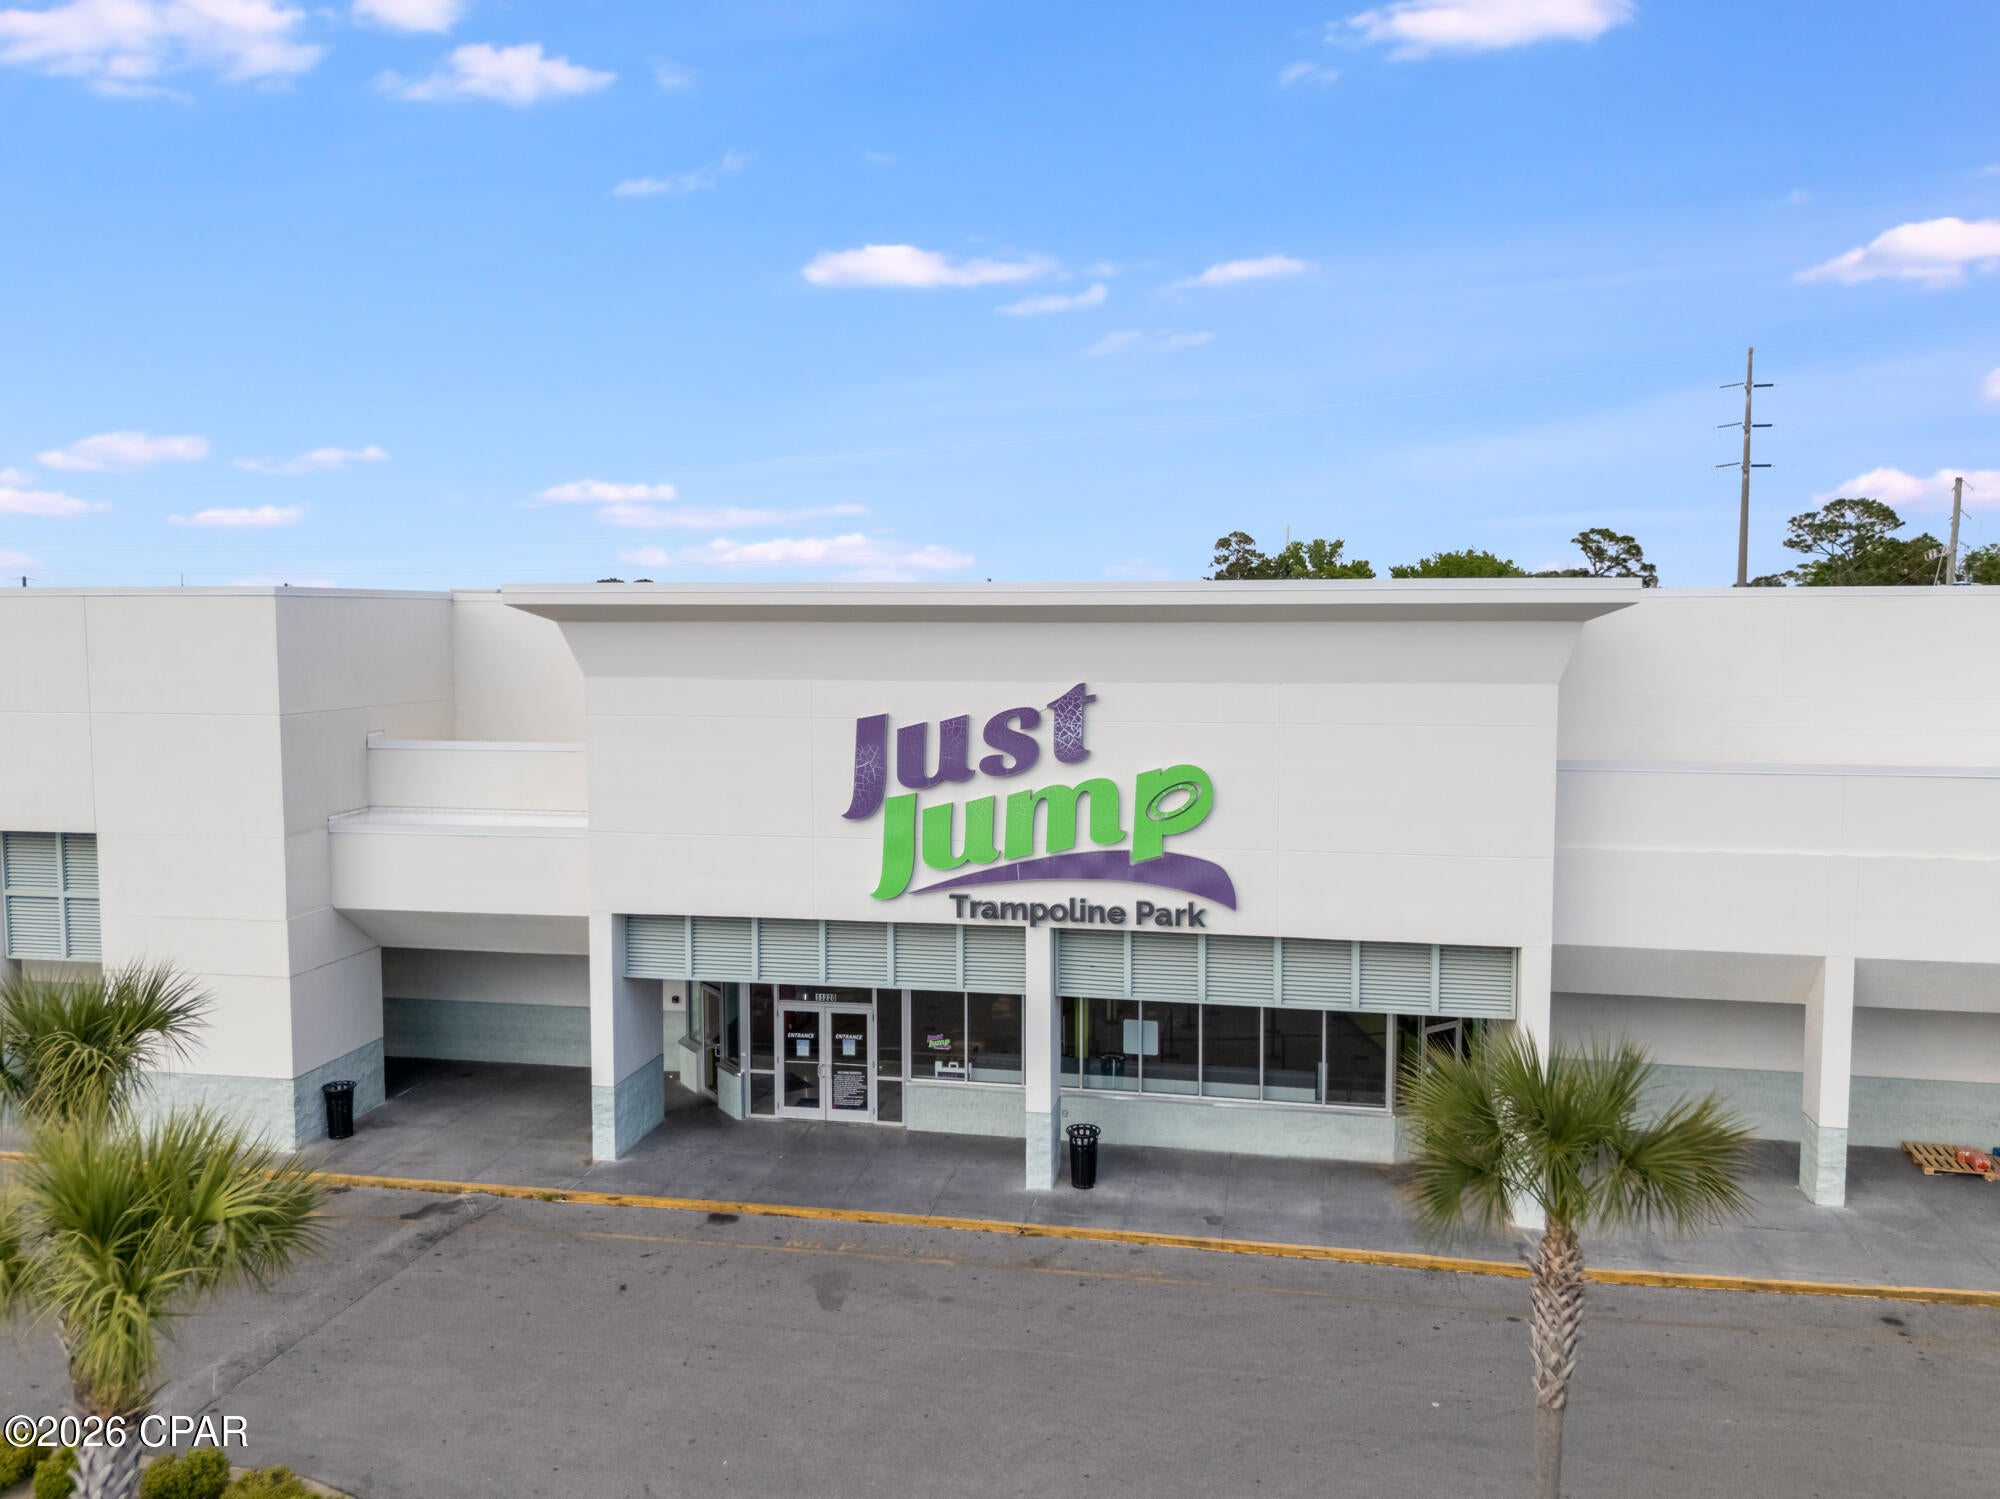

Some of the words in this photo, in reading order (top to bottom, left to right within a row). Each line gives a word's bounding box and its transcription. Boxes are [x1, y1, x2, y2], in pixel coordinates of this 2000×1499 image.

[841, 682, 1097, 820] Just
[870, 764, 1214, 901] Jump
[949, 893, 1127, 927] Trampoline
[1135, 900, 1207, 928] Park
